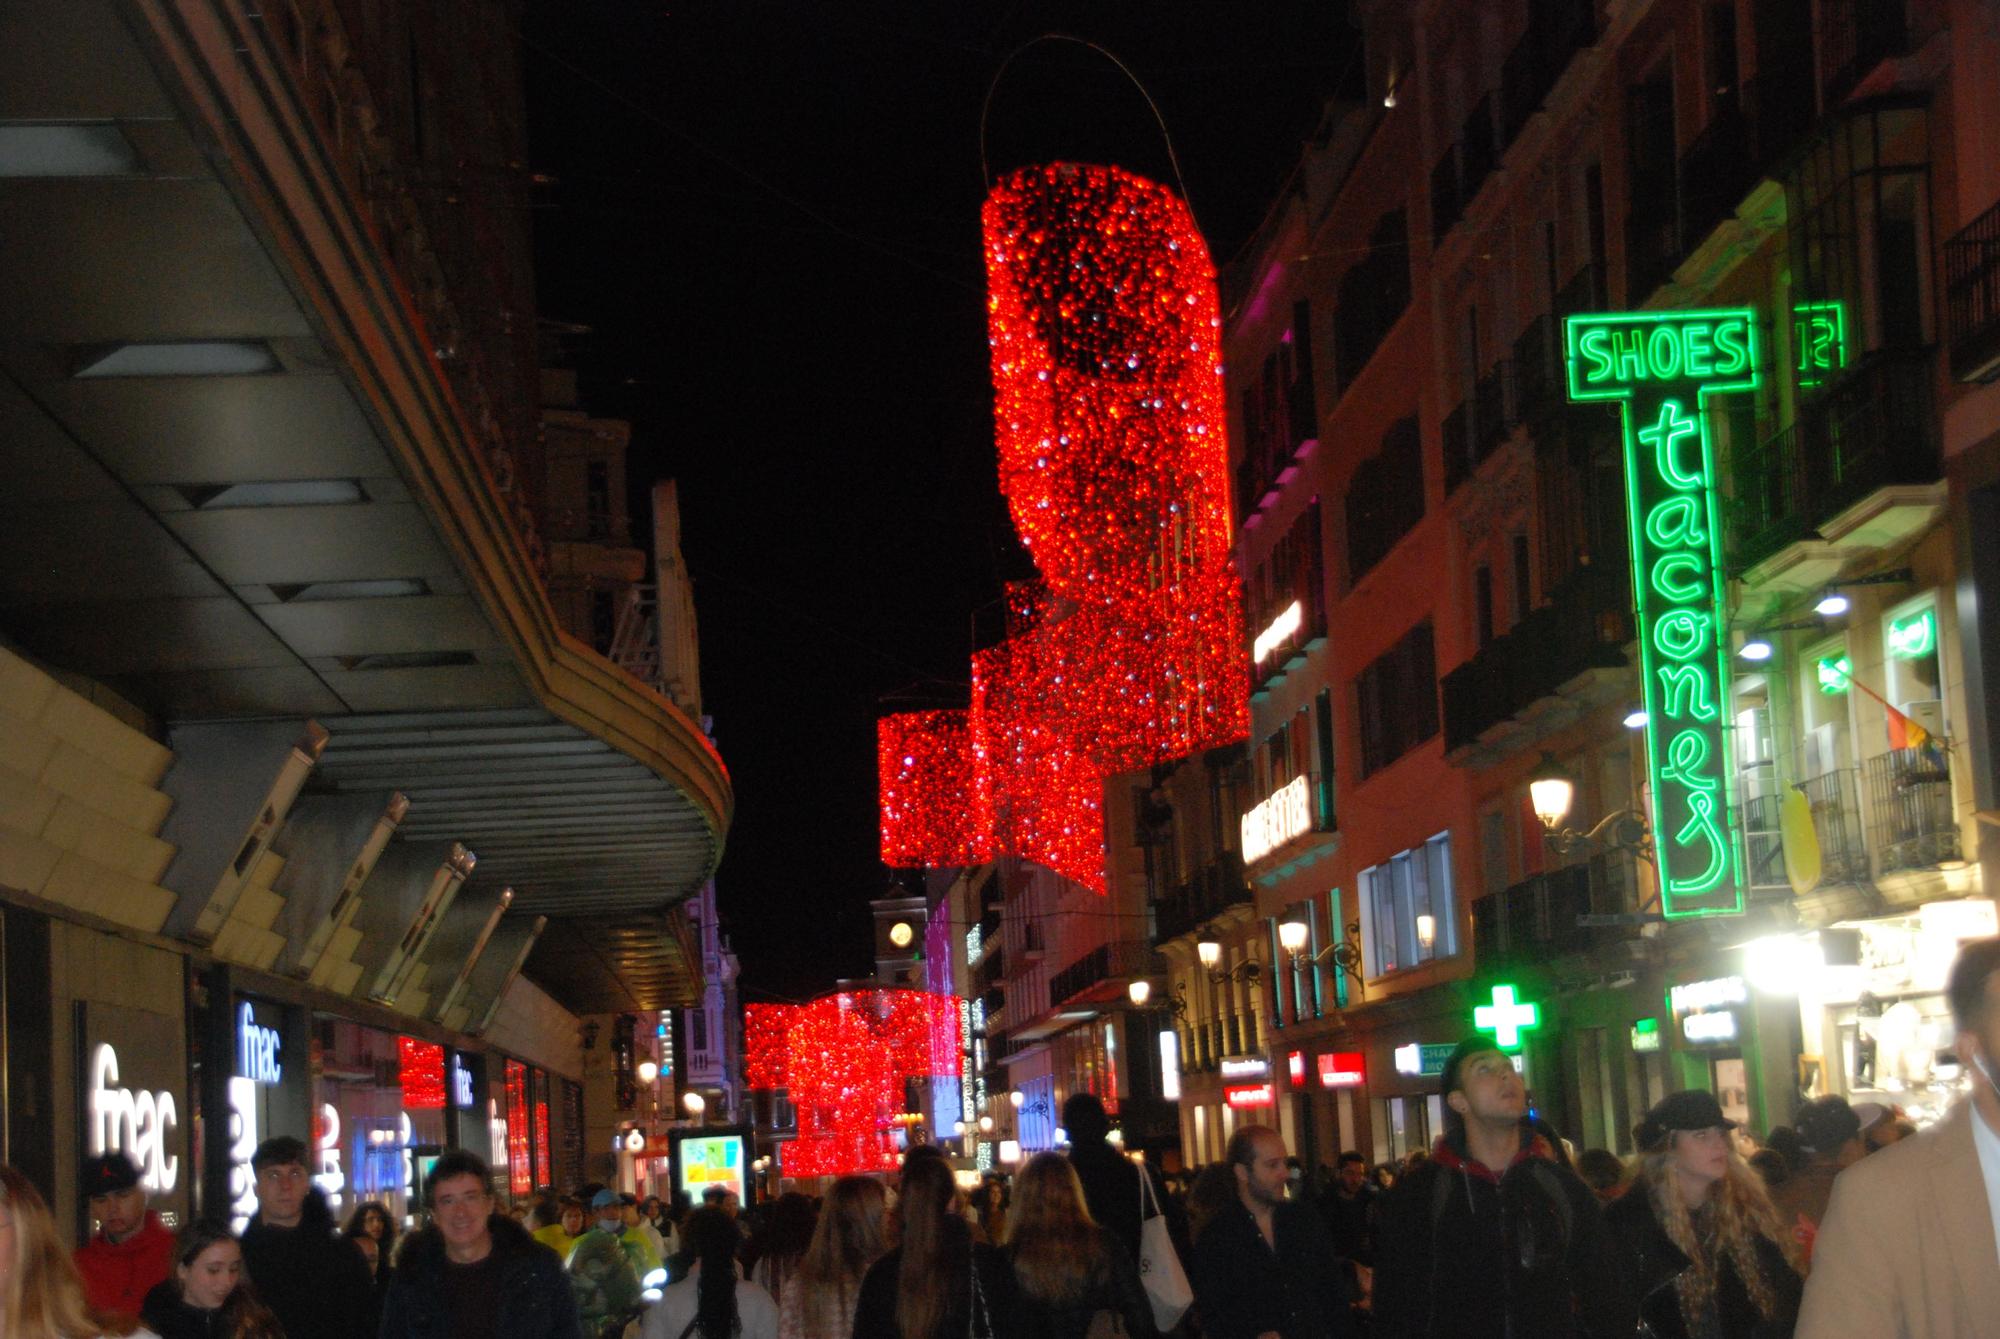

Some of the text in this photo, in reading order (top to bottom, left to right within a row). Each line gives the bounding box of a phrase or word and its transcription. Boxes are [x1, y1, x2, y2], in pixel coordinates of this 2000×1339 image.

[1580, 321, 1748, 381] SHOES
[1639, 401, 1728, 893] tacones
[240, 1002, 281, 1083] fnac
[960, 999, 971, 1050] 2000
[455, 1053, 473, 1105] fnac
[91, 1042, 179, 1190] fnac
[489, 1097, 508, 1166] fnac
